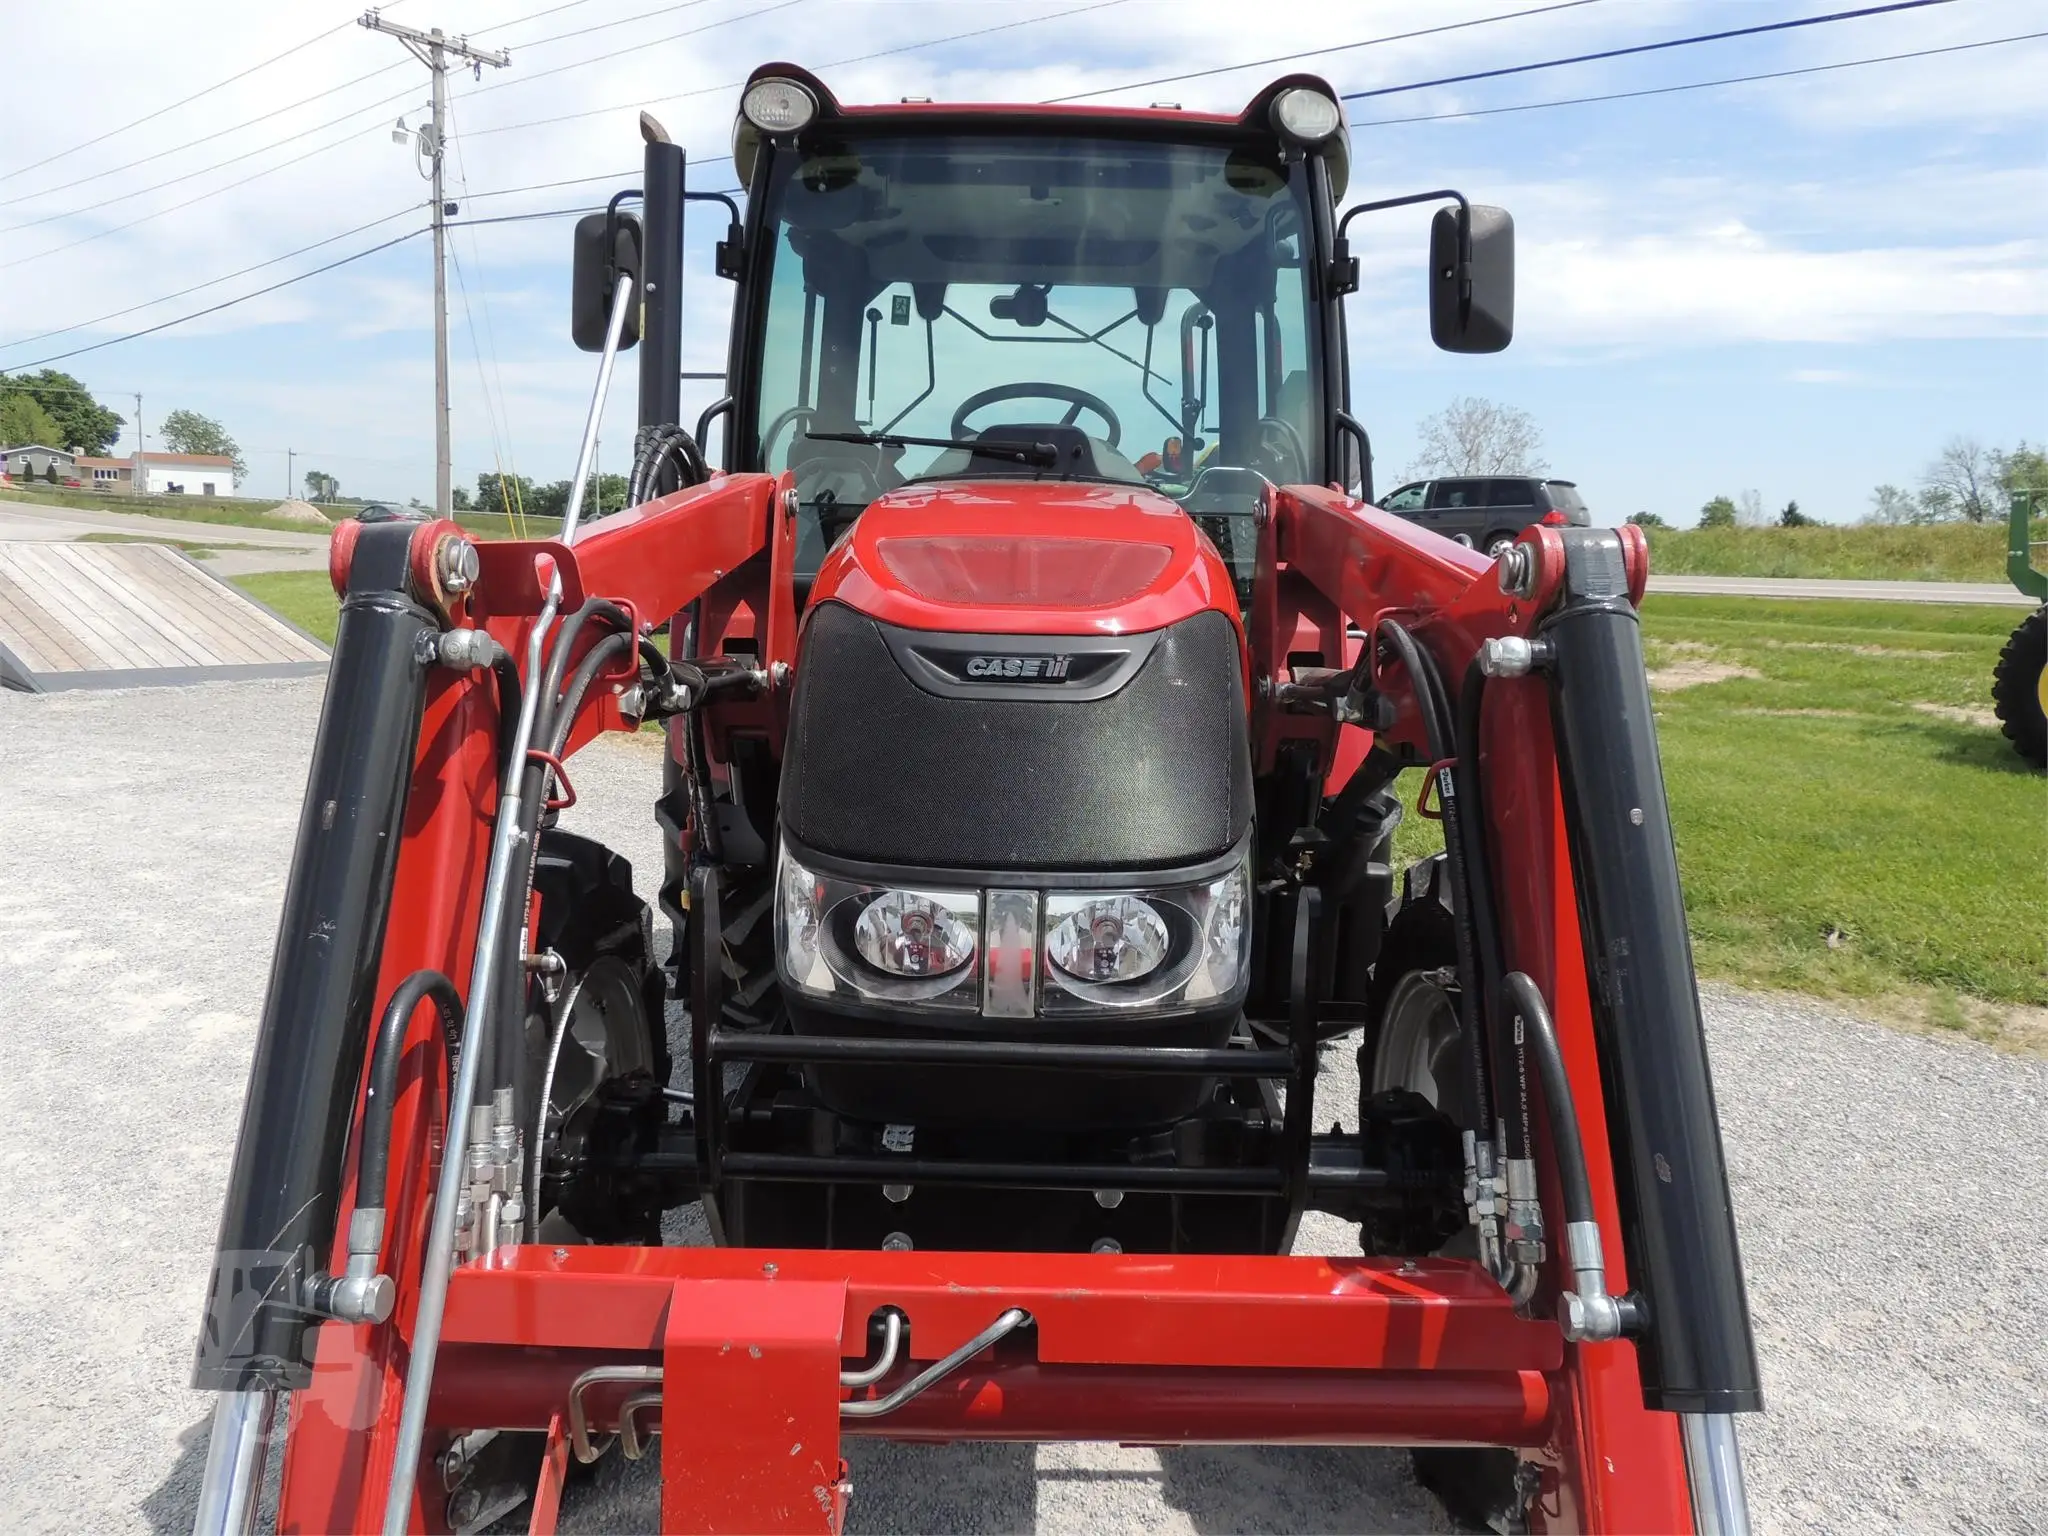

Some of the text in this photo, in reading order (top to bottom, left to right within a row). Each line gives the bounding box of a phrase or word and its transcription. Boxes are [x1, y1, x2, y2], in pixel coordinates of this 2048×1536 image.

[967, 657, 1039, 677] CASE
[1441, 769, 1453, 795] Parker
[448, 1029, 458, 1040] Up
[1520, 1074, 1526, 1090] WP
